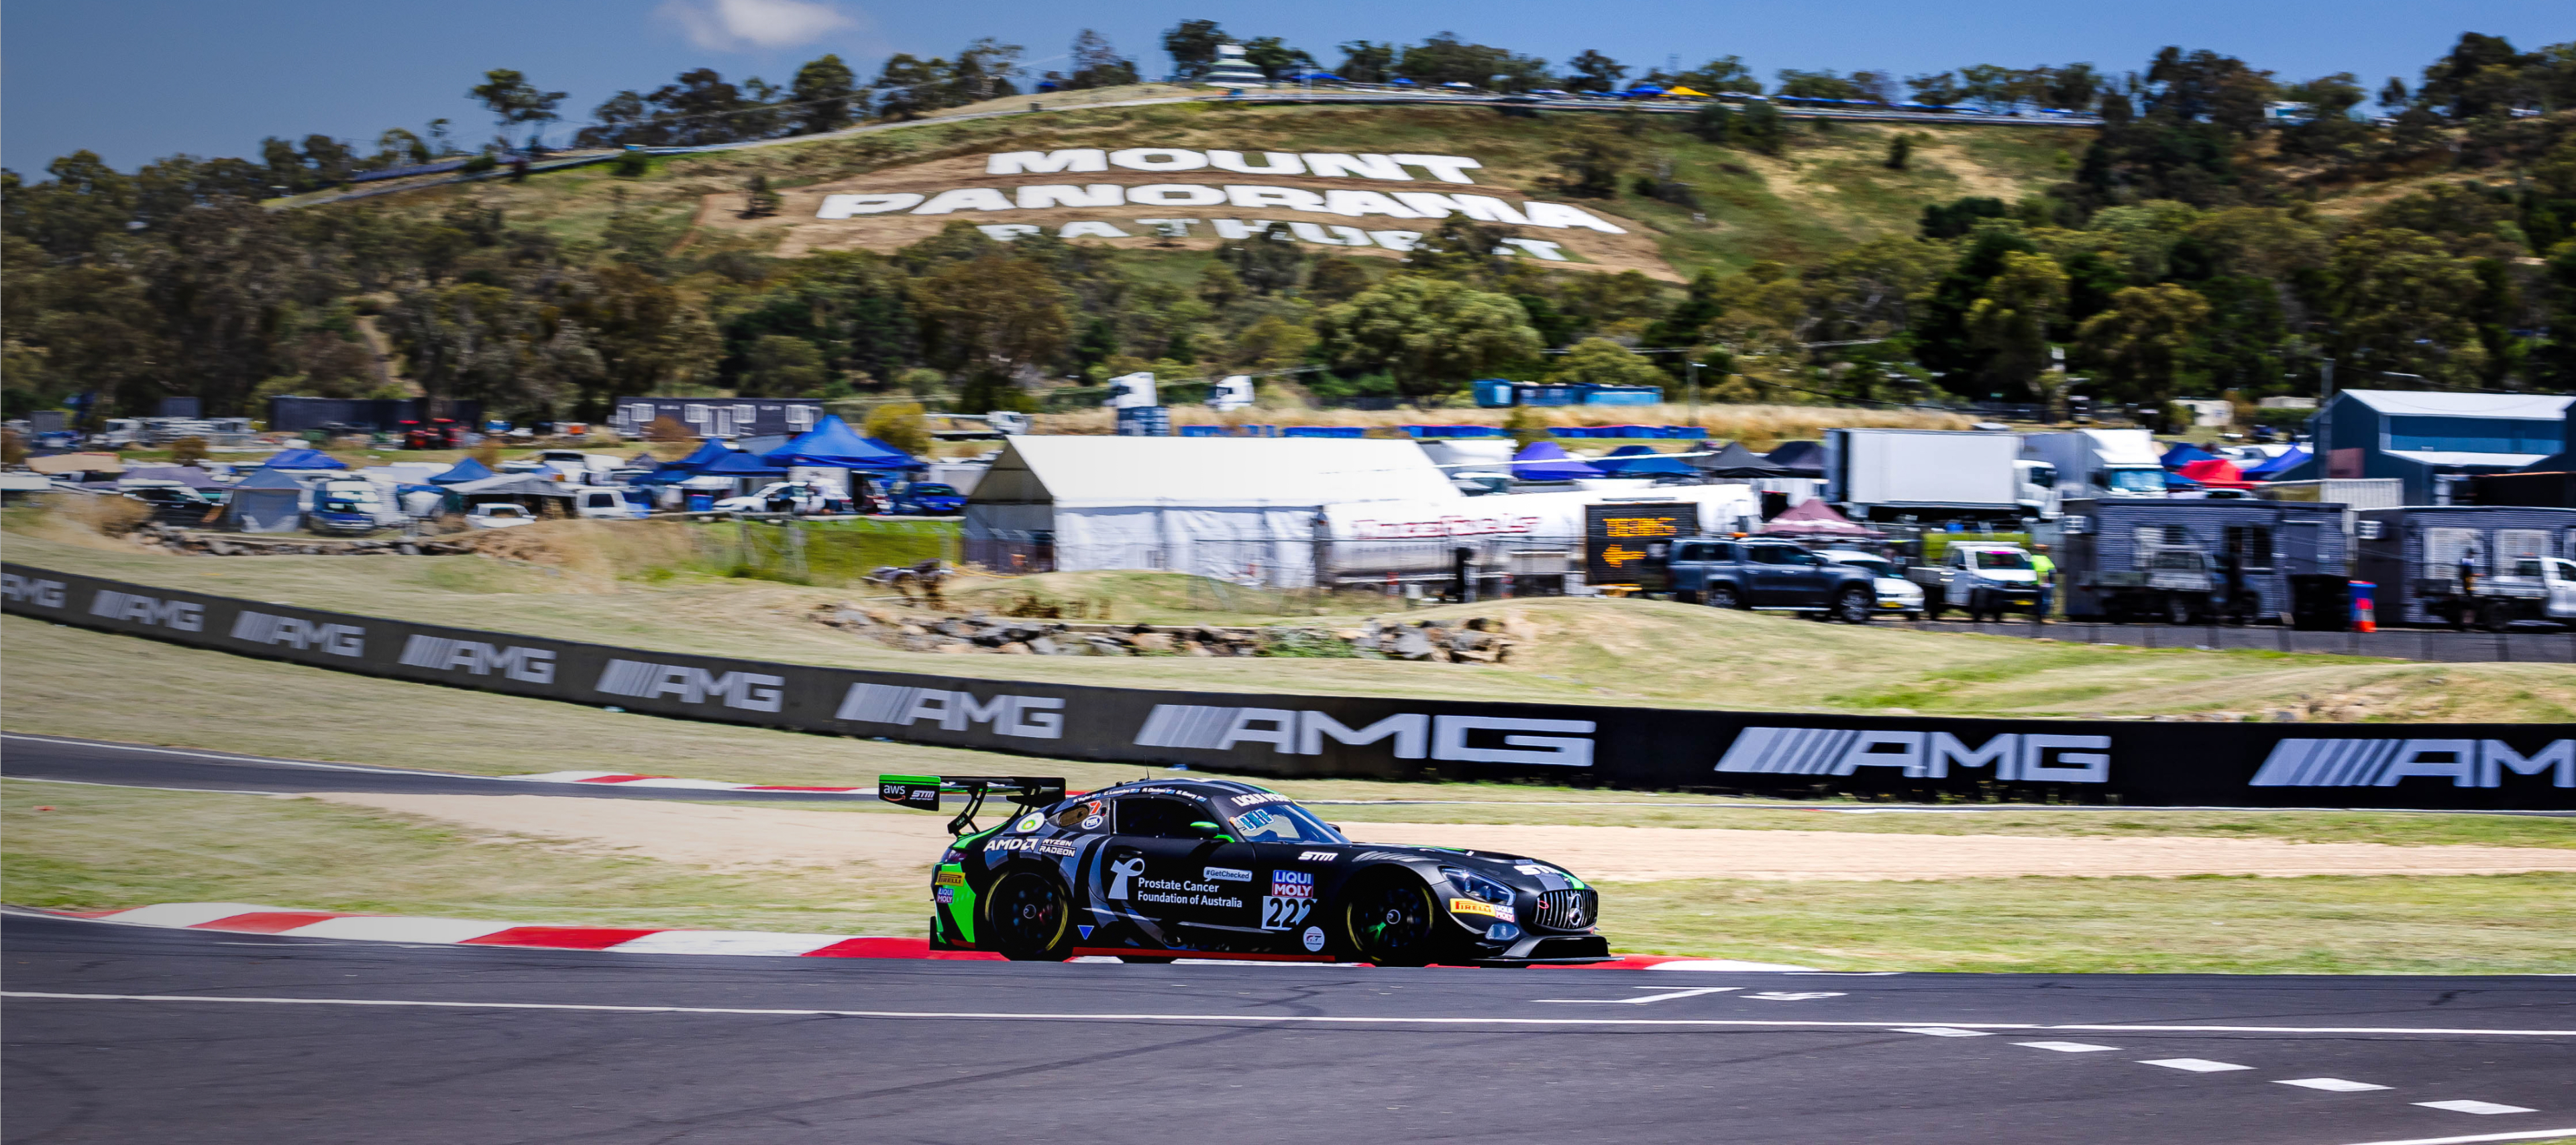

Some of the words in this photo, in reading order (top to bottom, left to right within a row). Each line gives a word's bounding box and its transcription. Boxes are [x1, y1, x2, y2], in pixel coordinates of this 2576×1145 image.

[987, 148, 1483, 185] MOUNT
[816, 183, 1628, 235] PANORAMA
[976, 218, 1568, 262] BATHURT
[267, 616, 366, 657] AMG
[441, 639, 557, 684] AMG
[649, 665, 786, 713] AMG
[897, 686, 1066, 739] AMG
[1215, 707, 1596, 767] AMG
[1829, 730, 2112, 783] AMG
[883, 785, 906, 795] aws
[911, 790, 935, 798] STM
[983, 838, 1023, 852] AMD
[1042, 838, 1073, 847] RYZEN
[1039, 846, 1075, 857] RADEON
[1298, 851, 1338, 861] STM
[938, 873, 962, 883] PIRELLI
[1205, 870, 1250, 879] #GetChecked
[1275, 871, 1311, 884] LIQUI
[1138, 877, 1181, 890] Prostate
[1183, 880, 1220, 893] Cancer
[1274, 884, 1312, 896] MOLY
[1138, 891, 1188, 904] Foundation
[1189, 895, 1199, 905] of
[1201, 895, 1242, 908] Australia
[1456, 901, 1491, 913] PIRELLI
[1266, 897, 1315, 929] 222
